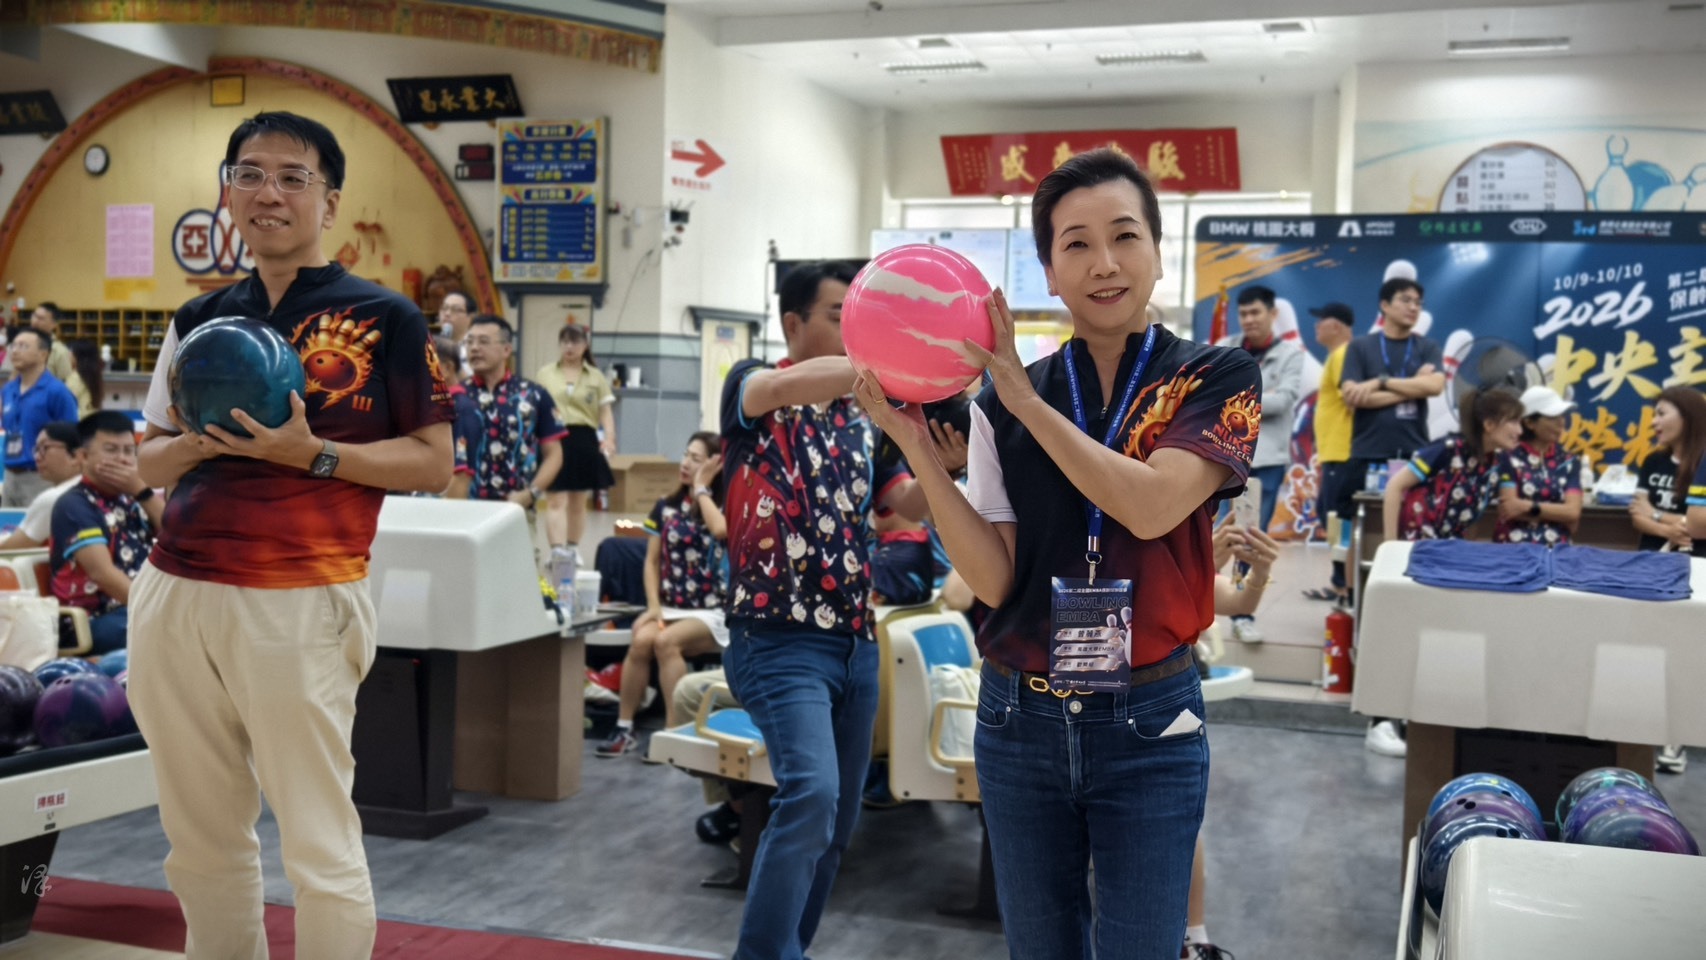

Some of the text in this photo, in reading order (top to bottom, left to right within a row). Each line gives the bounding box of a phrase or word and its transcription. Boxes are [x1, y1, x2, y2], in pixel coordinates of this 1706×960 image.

[1209, 222, 1249, 235] BMW
[1553, 263, 1643, 291] 10/9-10/10
[1533, 281, 1653, 340] 2026
[1545, 326, 1706, 403] 中央主
[1202, 429, 1253, 464] BOWLING CLU
[1213, 424, 1252, 454] NUKE
[1648, 473, 1674, 488] CEL
[1056, 596, 1130, 609] BOWLING
[1056, 611, 1101, 623] EMBA
